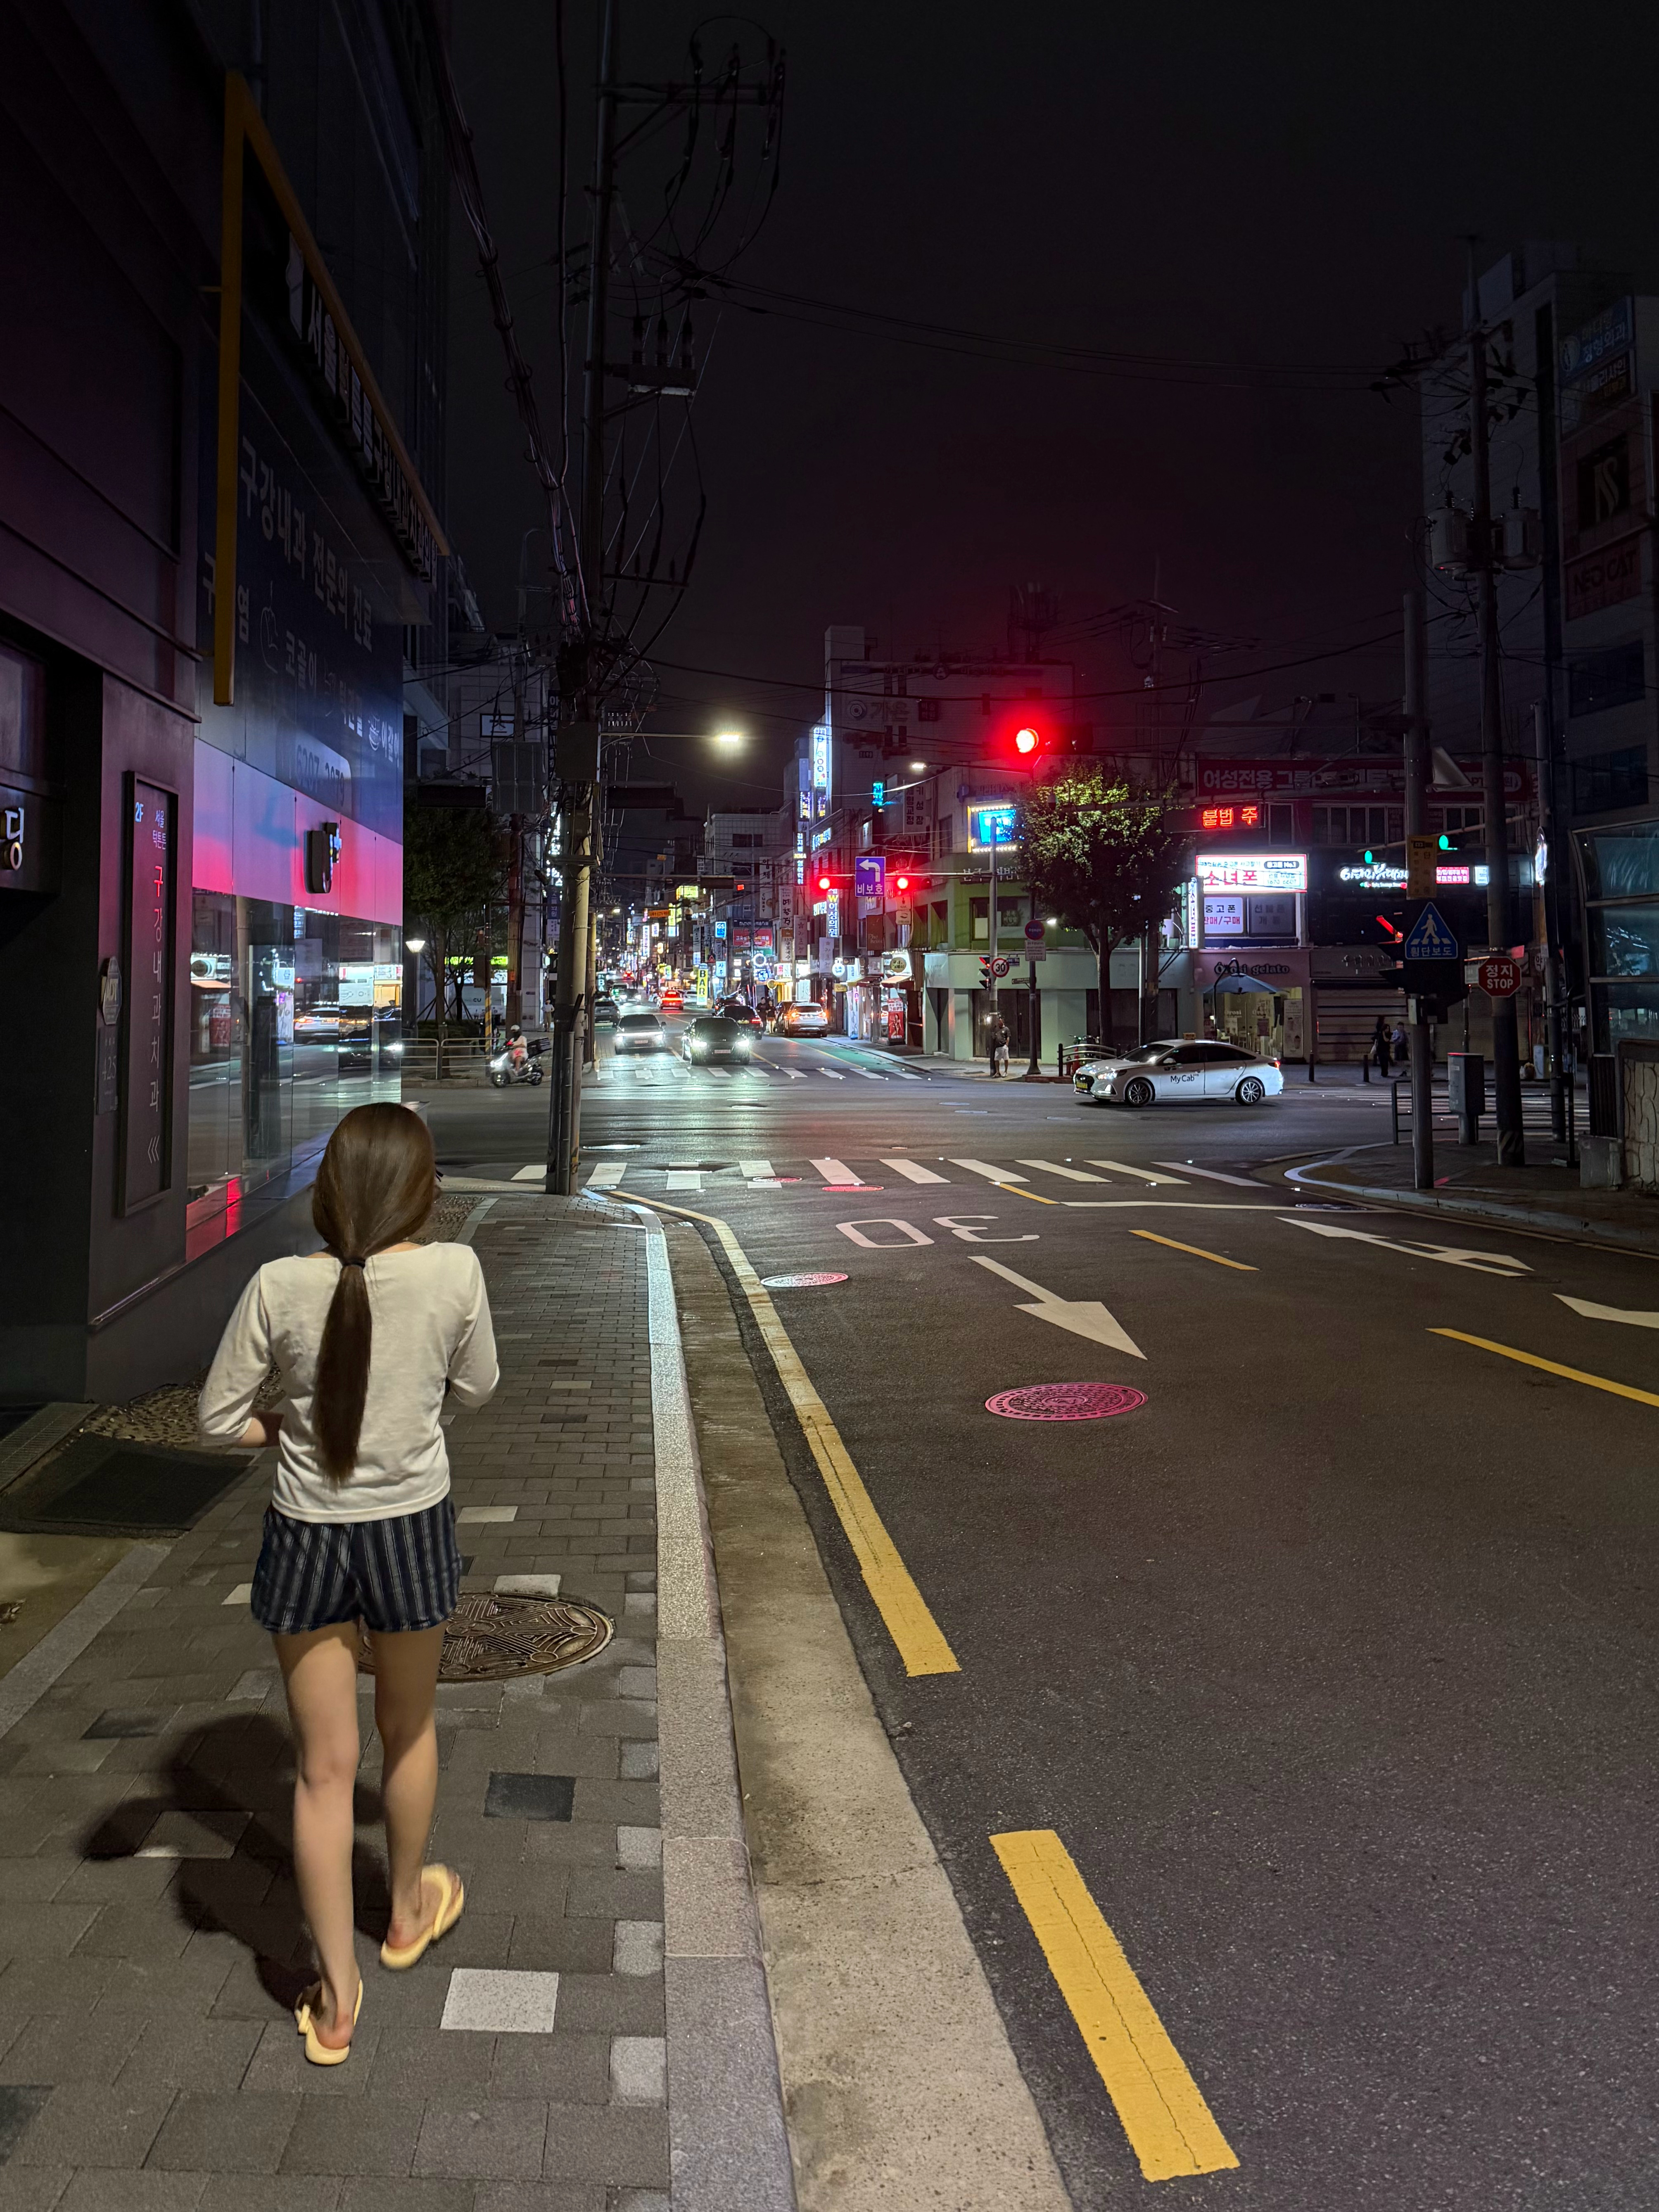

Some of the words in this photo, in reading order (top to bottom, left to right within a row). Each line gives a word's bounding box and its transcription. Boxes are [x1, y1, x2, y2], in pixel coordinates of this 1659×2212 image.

[241, 435, 306, 580] 구강내과
[313, 530, 348, 630] 전문의
[354, 585, 373, 653] 진료
[203, 551, 249, 644] 구염
[285, 630, 317, 698] 코골이
[1203, 769, 1273, 790] 여성전용
[135, 801, 144, 822] 2F
[1203, 807, 1234, 828] 불법
[857, 883, 883, 895] 비보호
[1205, 904, 1236, 913] 중고폰
[1410, 946, 1453, 957] 횡단보도
[995, 963, 1005, 972] 30
[1251, 964, 1290, 975] gelato
[1486, 964, 1513, 978] 정지
[1487, 978, 1514, 989] STOP
[1181, 1074, 1195, 1082] Cab
